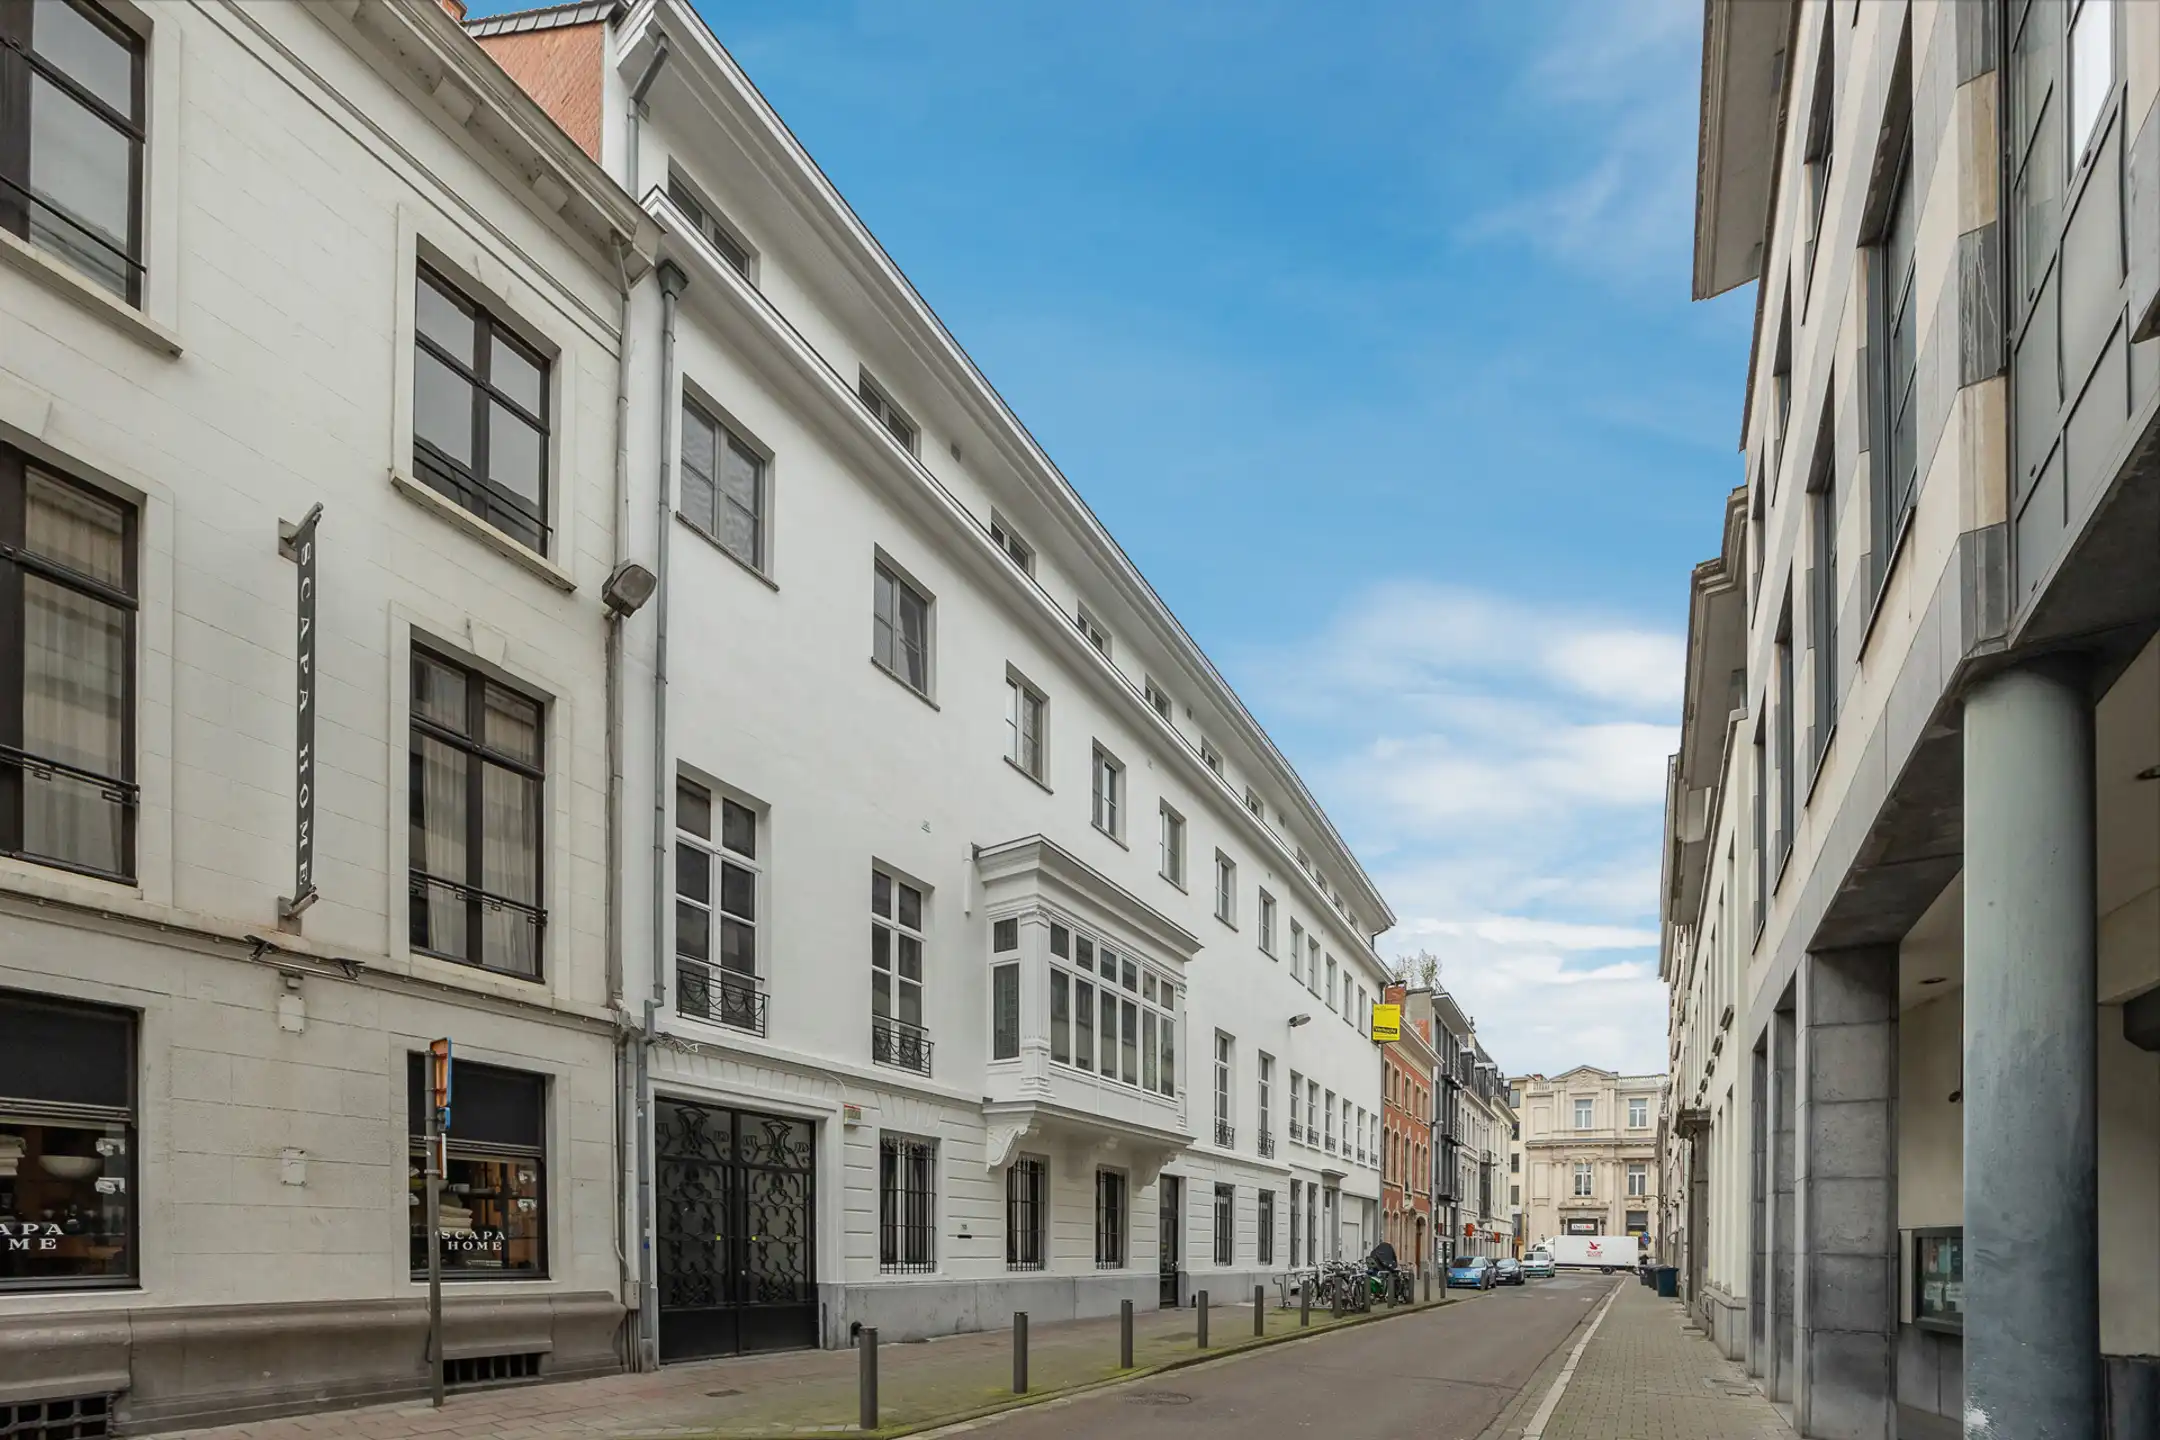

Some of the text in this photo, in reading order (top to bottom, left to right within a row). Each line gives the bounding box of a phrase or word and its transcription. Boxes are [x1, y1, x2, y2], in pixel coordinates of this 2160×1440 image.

[299, 541, 312, 885] SCAPA HOME
[441, 1230, 506, 1241] SCAPA
[447, 1241, 502, 1251] HOME
